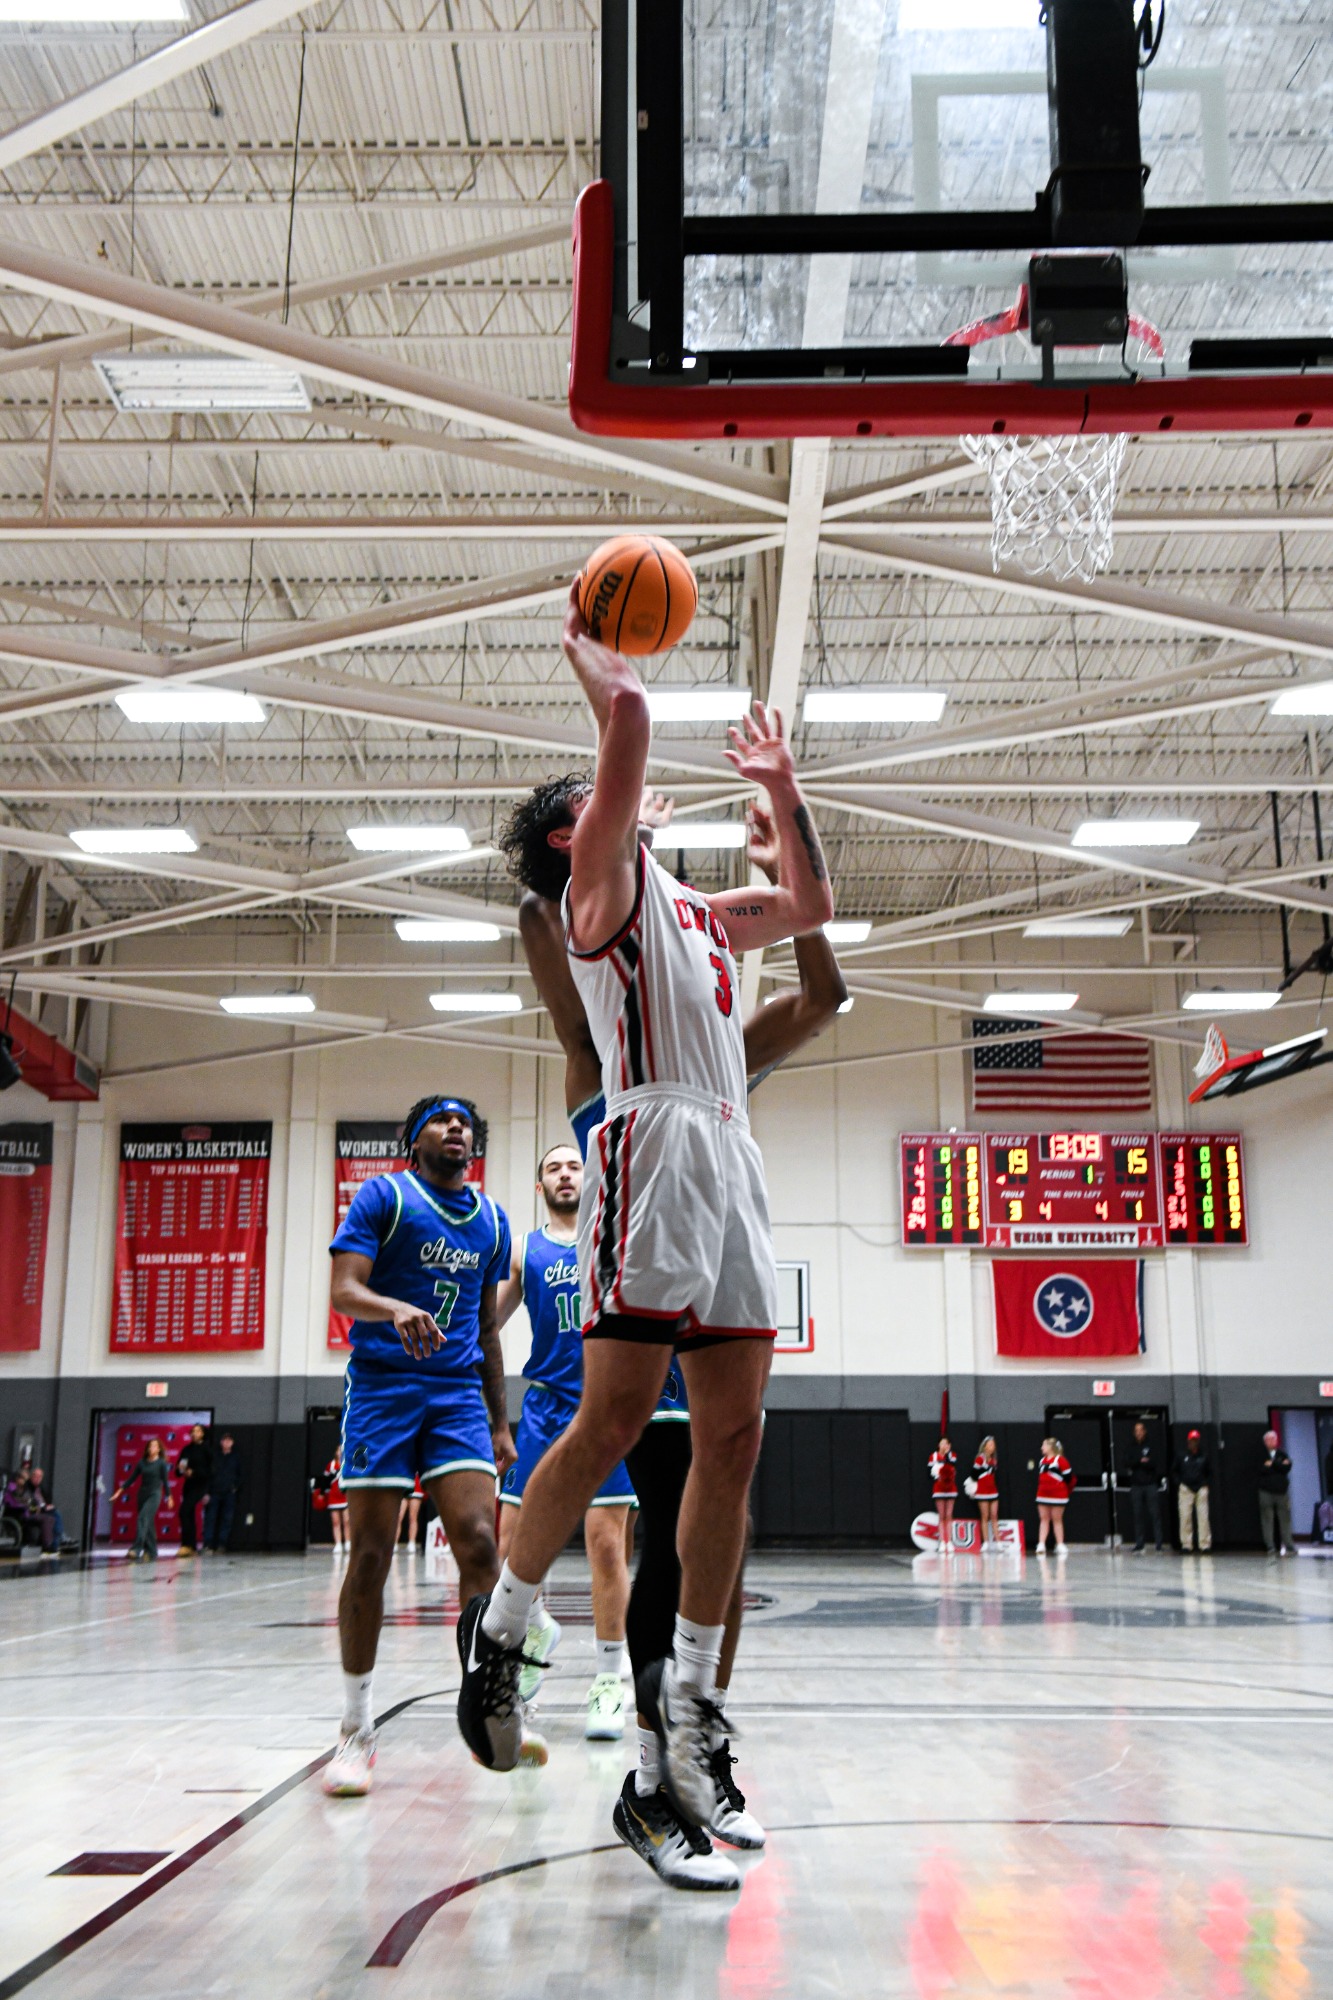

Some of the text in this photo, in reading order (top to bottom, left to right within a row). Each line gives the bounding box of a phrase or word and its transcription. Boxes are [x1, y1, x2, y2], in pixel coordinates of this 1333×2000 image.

[709, 952, 733, 1018] 3
[124, 1140, 268, 1159] WOMEN'S BASKETBALL
[338, 1140, 399, 1158] WOMEN'S
[990, 1135, 1030, 1147] GUEST
[1049, 1133, 1100, 1160] 13:09
[1111, 1135, 1149, 1147] UNION
[918, 1147, 925, 1163] 1
[940, 1146, 951, 1164] 0
[1008, 1148, 1028, 1174] 19
[1127, 1148, 1148, 1174] 15
[1177, 1146, 1184, 1162] 1
[1200, 1146, 1210, 1163] 0
[913, 1163, 925, 1180] 4
[945, 1163, 952, 1180] 1
[1040, 1164, 1094, 1185] PERIOD 1
[1200, 1162, 1211, 1179] 0
[945, 1179, 952, 1196] 1
[1044, 1190, 1101, 1199] TIME OUTS LEFT
[1206, 1179, 1212, 1195] 1
[941, 1196, 952, 1213] 0
[1009, 1200, 1023, 1221] 3
[1039, 1200, 1052, 1221] 4
[1095, 1200, 1108, 1221] 4
[1135, 1200, 1143, 1221] 1
[1203, 1195, 1213, 1212] 0
[942, 1212, 953, 1229] 0
[1203, 1211, 1215, 1229] 0
[1058, 1231, 1136, 1243] UNIVERSITY
[420, 1236, 480, 1274] Argos
[544, 1259, 580, 1285] Arg
[433, 1279, 460, 1329] 7
[555, 1292, 583, 1333] 10
